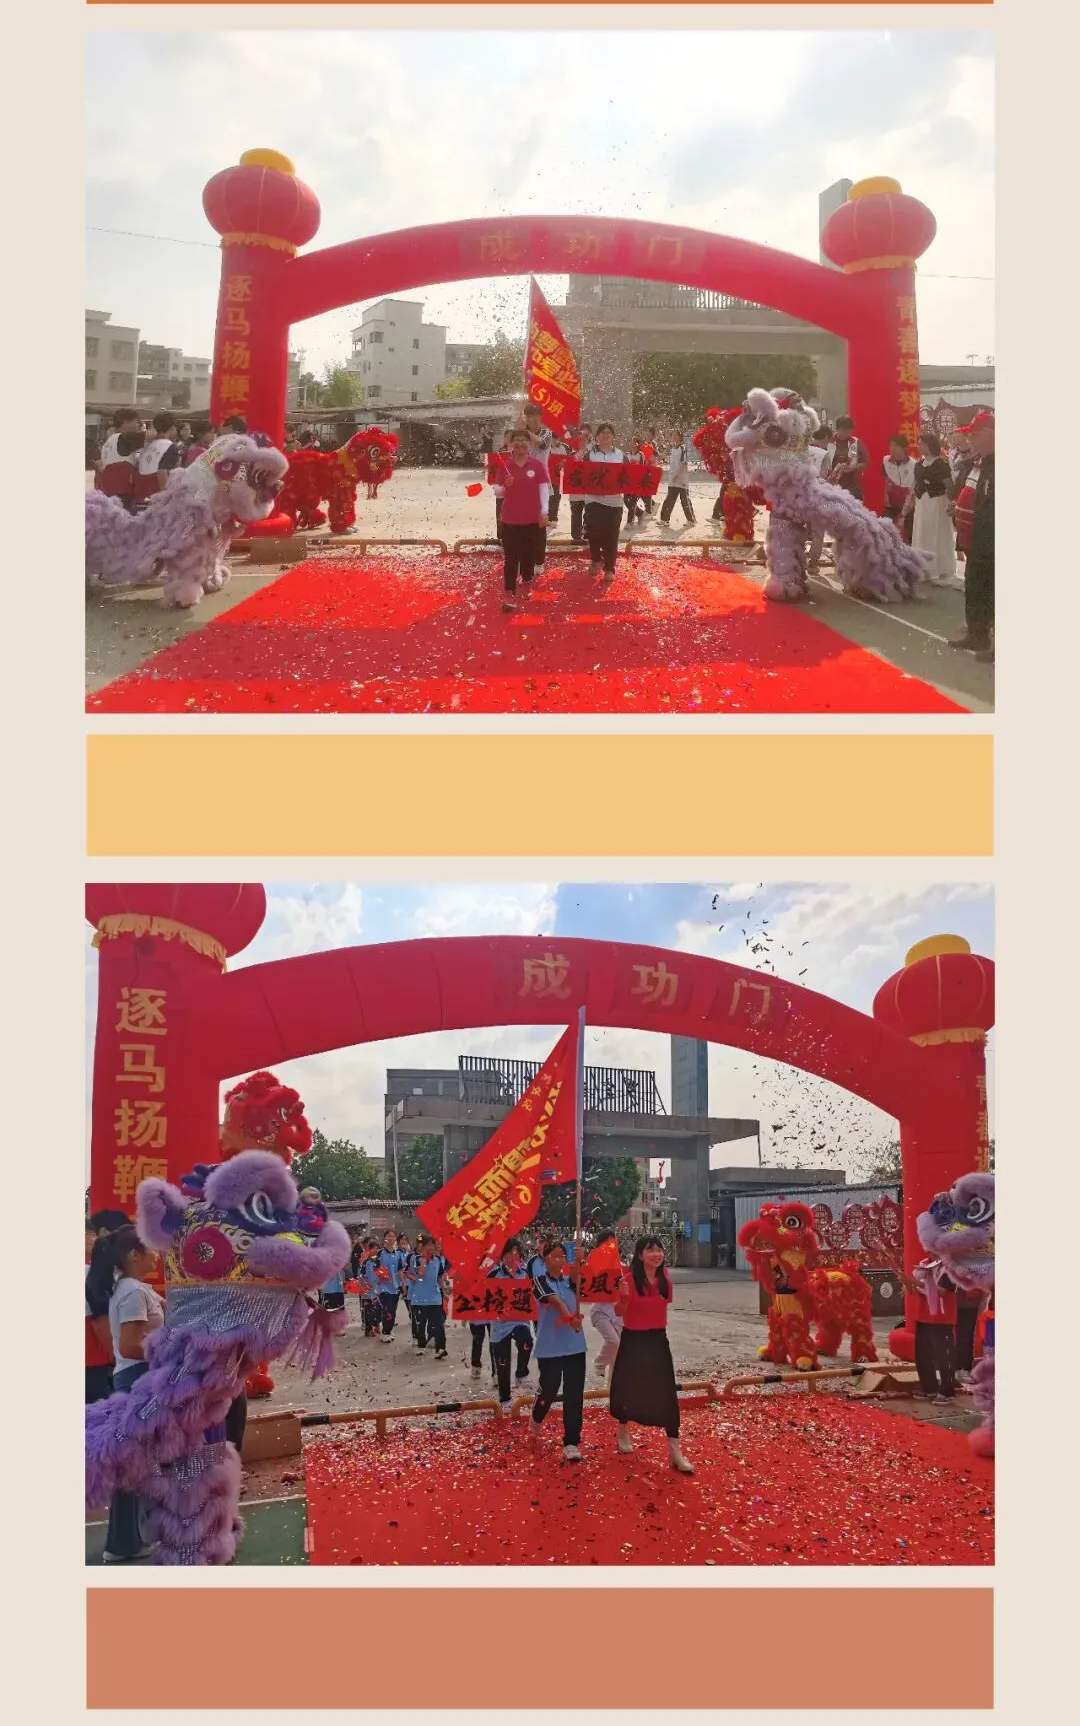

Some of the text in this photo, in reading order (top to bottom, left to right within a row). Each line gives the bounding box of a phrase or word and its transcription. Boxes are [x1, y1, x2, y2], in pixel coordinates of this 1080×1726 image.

[480, 230, 683, 266] 成功门
[518, 952, 772, 1018] 成功门
[114, 986, 168, 1204] 逐马扬鞭
